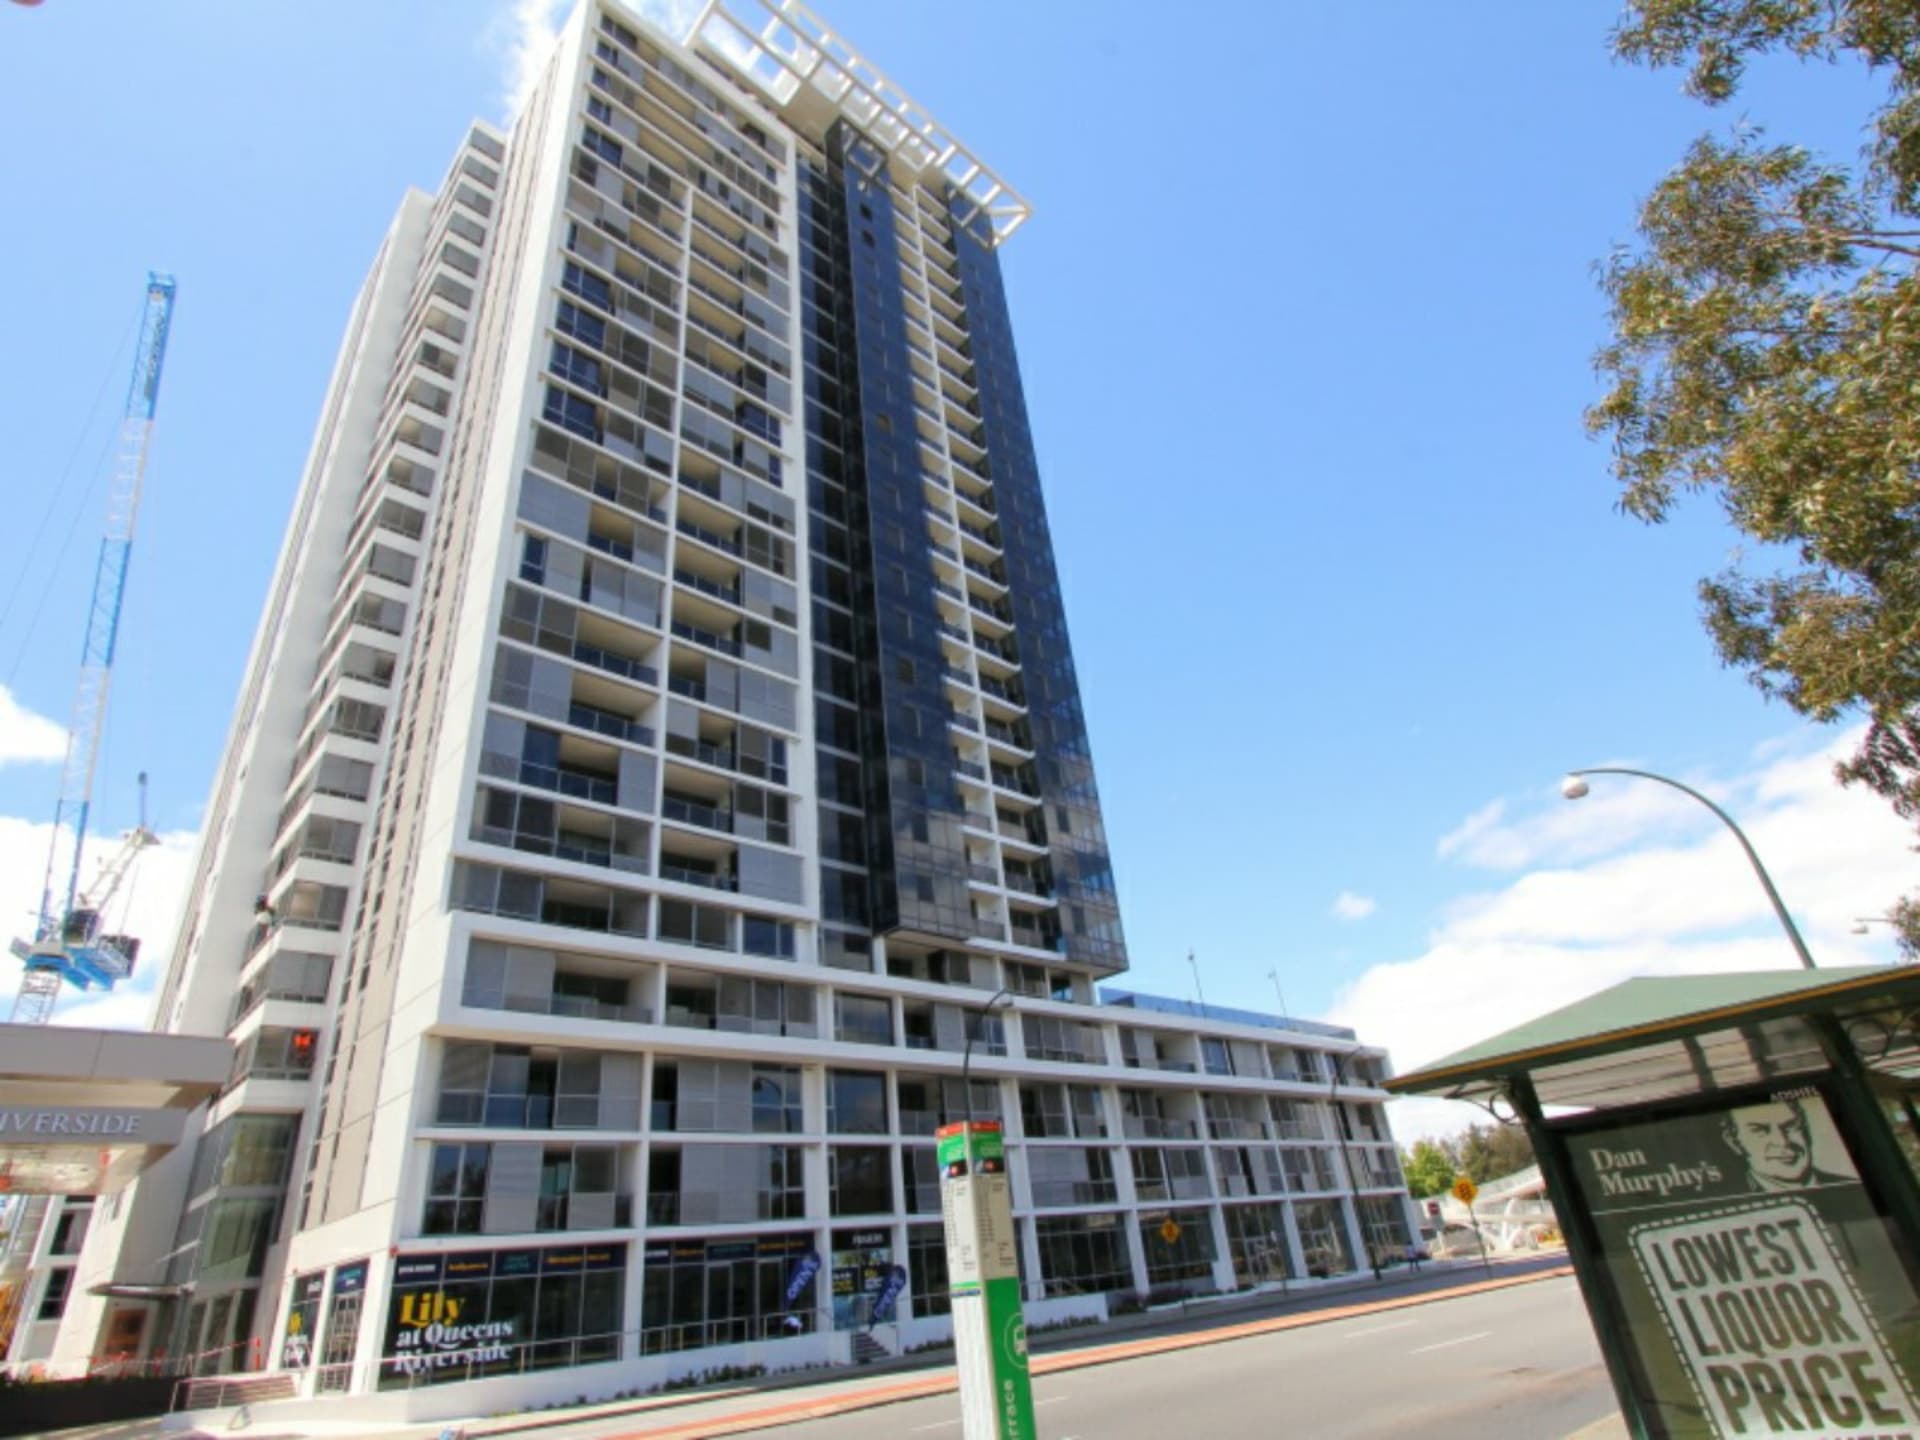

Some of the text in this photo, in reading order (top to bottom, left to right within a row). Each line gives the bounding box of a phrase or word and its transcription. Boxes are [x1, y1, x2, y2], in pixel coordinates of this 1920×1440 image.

[0, 1112, 141, 1133] IVERSIDE
[1590, 1147, 1647, 1171] Dan
[1600, 1160, 1722, 1196] Murphy's
[1651, 1219, 1817, 1291] LOWEST
[401, 1291, 462, 1326] Lily
[1676, 1278, 1861, 1358] LIQUOR
[396, 1319, 513, 1349] at Queens
[393, 1340, 512, 1375] Riverside
[1706, 1350, 1905, 1434] PRICE
